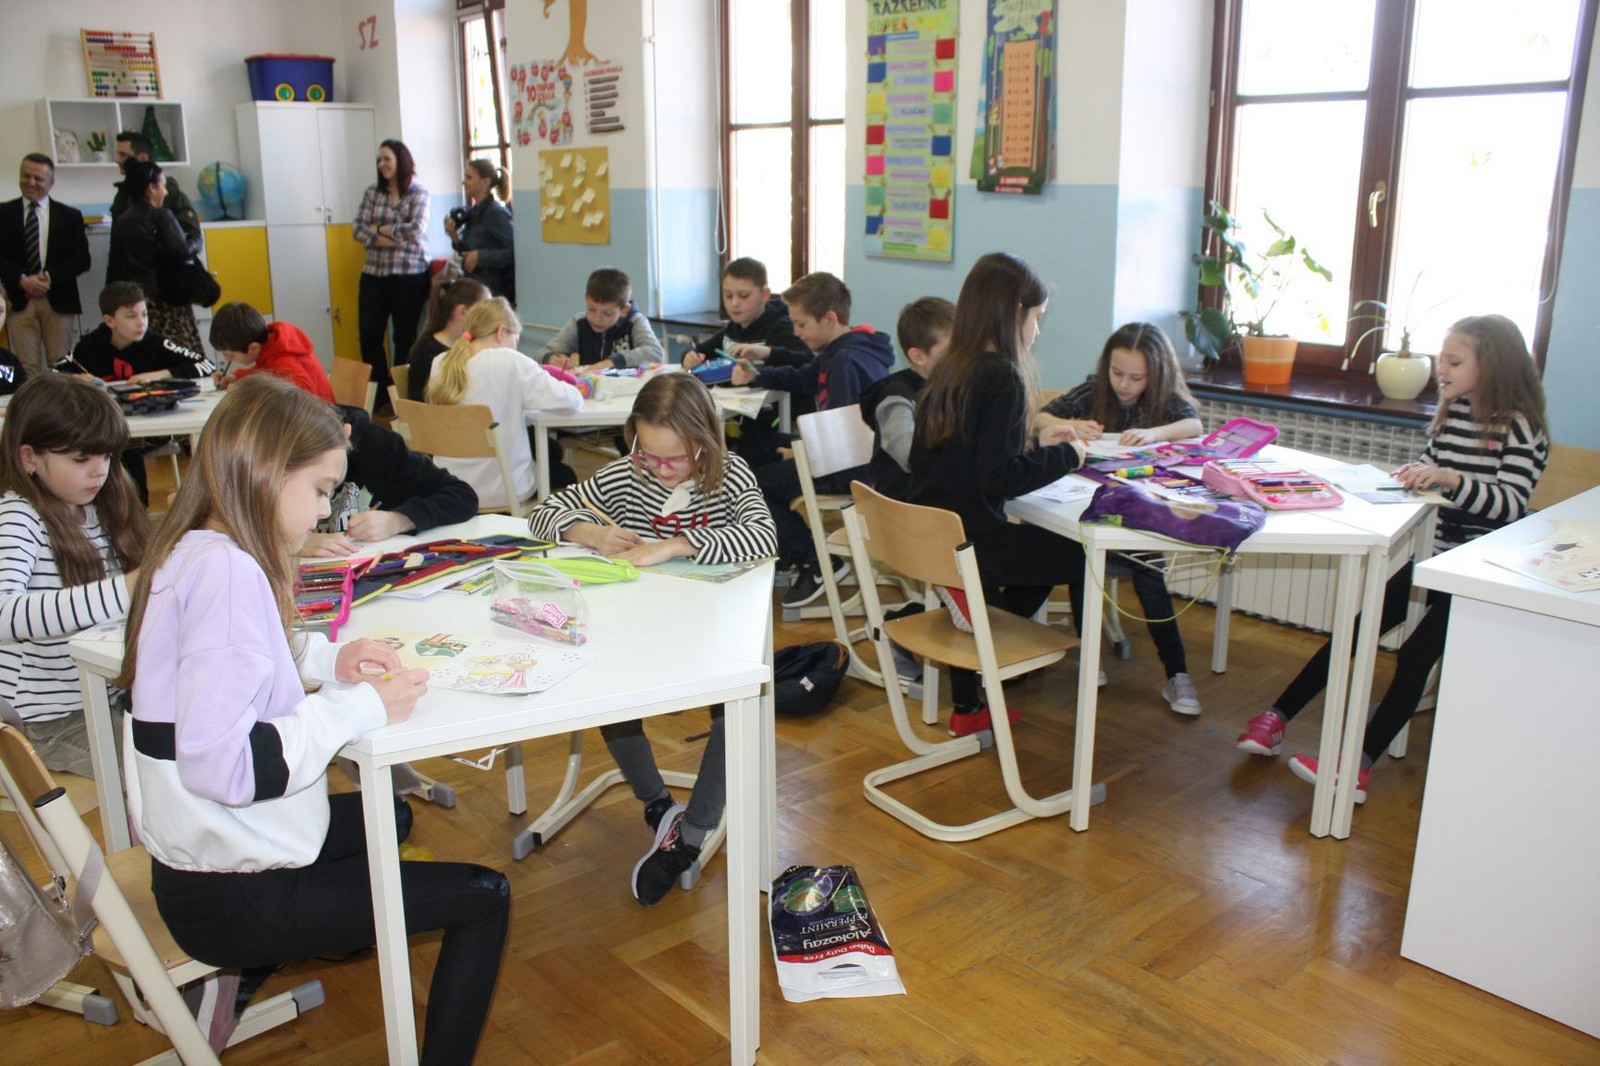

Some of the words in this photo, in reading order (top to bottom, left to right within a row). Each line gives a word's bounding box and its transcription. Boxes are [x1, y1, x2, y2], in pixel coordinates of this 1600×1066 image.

[799, 912, 868, 935] PEPPERMINT
[802, 928, 872, 950] Alokozay
[802, 953, 824, 961] Free
[825, 947, 848, 958] Duty
